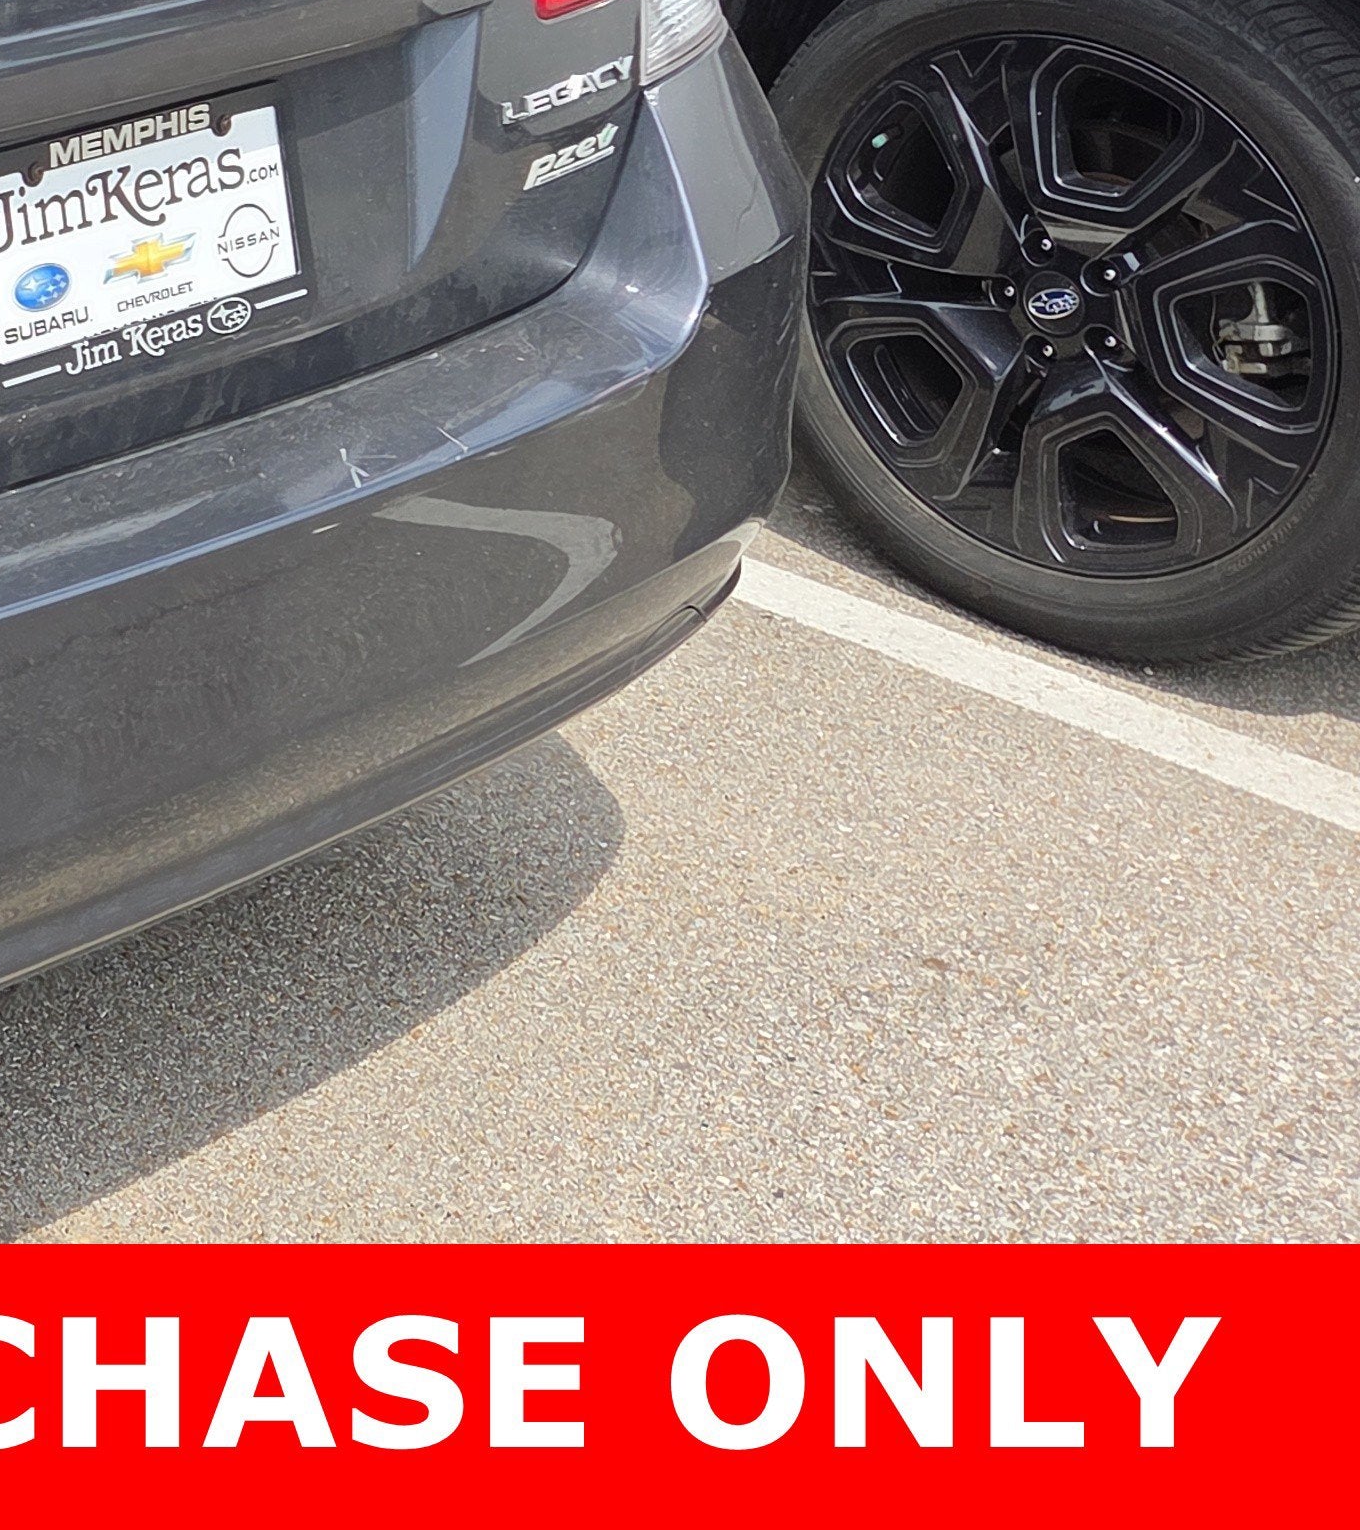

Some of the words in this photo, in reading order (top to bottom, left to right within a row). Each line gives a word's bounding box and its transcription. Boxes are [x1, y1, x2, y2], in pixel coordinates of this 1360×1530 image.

[501, 55, 633, 125] LEGACY
[49, 103, 211, 168] MEMPHIS
[217, 226, 281, 256] NISSAN
[116, 281, 194, 313] CHEVROLET
[64, 338, 123, 376] Jim
[122, 314, 204, 357] Keras
